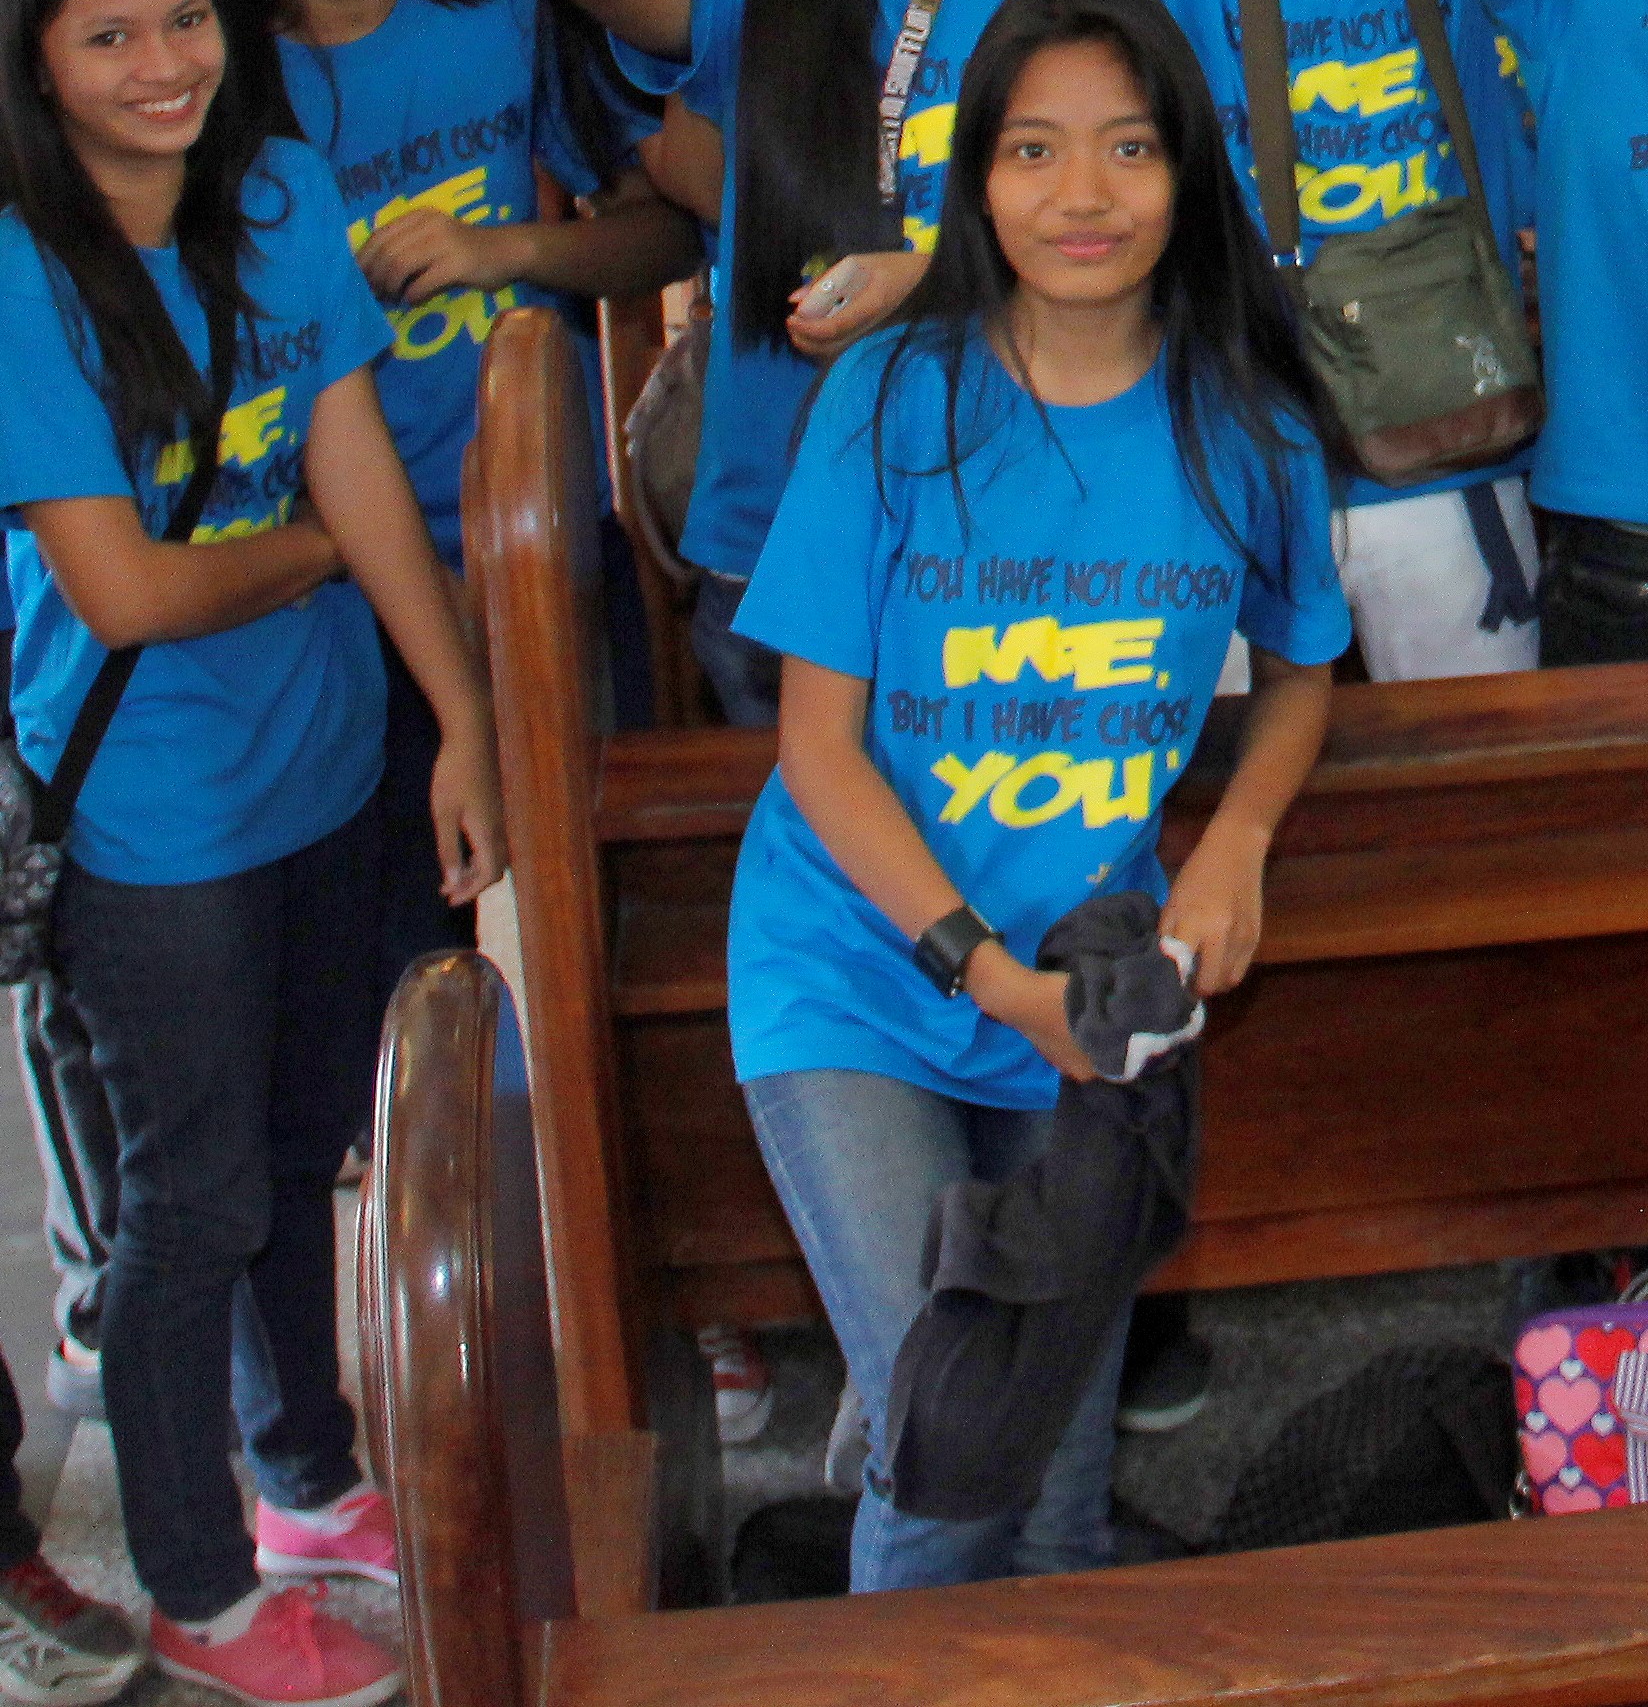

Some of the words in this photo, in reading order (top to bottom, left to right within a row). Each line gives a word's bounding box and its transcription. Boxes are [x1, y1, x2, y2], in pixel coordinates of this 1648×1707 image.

[1064, 560, 1129, 608] NOT
[888, 690, 948, 744] BUT
[962, 699, 975, 742] I
[992, 697, 1086, 745] HAVE
